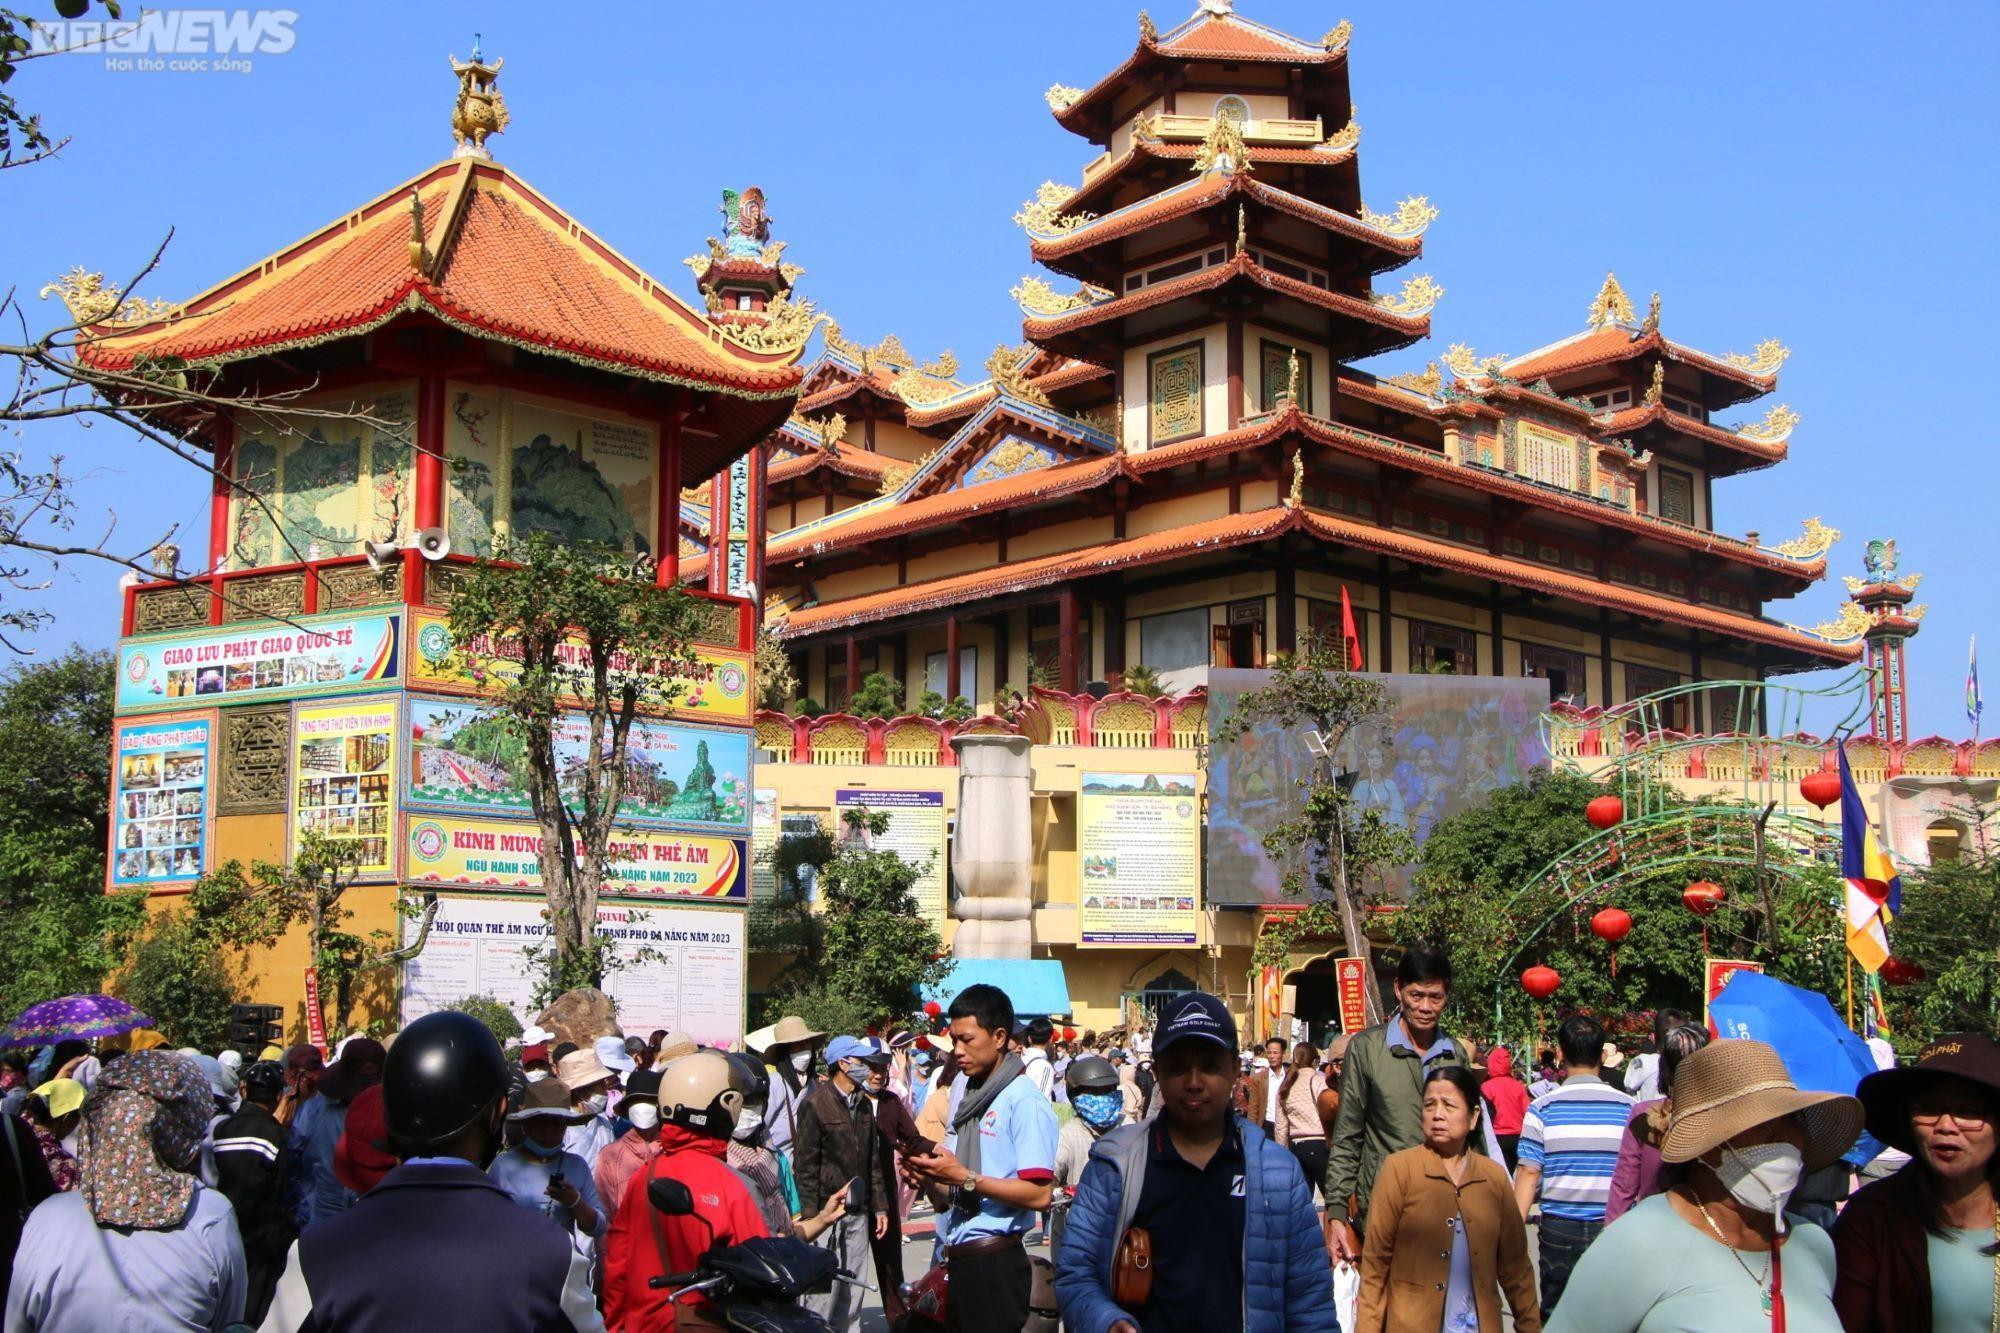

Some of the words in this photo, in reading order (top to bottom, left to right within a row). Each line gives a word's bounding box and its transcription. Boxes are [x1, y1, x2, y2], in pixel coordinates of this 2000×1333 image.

[163, 648, 193, 665] GIAO
[197, 644, 219, 662] LƯU
[223, 638, 257, 661] PHẬT
[261, 634, 292, 655] GIÁO
[296, 627, 331, 654] QUỐC
[336, 625, 353, 646] TẾ
[453, 828, 495, 851] KÍNH
[653, 840, 682, 862] THẾ
[686, 843, 709, 864] ÂM
[466, 858, 488, 872] NGŨ
[491, 860, 519, 874] HÀNH
[650, 870, 671, 883] NĂM
[673, 871, 698, 884] 2023
[436, 920, 454, 933] HỘI
[485, 920, 505, 934] THẾ
[507, 921, 522, 935] ÂM
[630, 926, 648, 940] PHỐ
[664, 926, 688, 941] NẴNG
[690, 929, 709, 943] NĂM
[711, 933, 731, 943] 2023
[1168, 1021, 1188, 1031] VIETNAM
